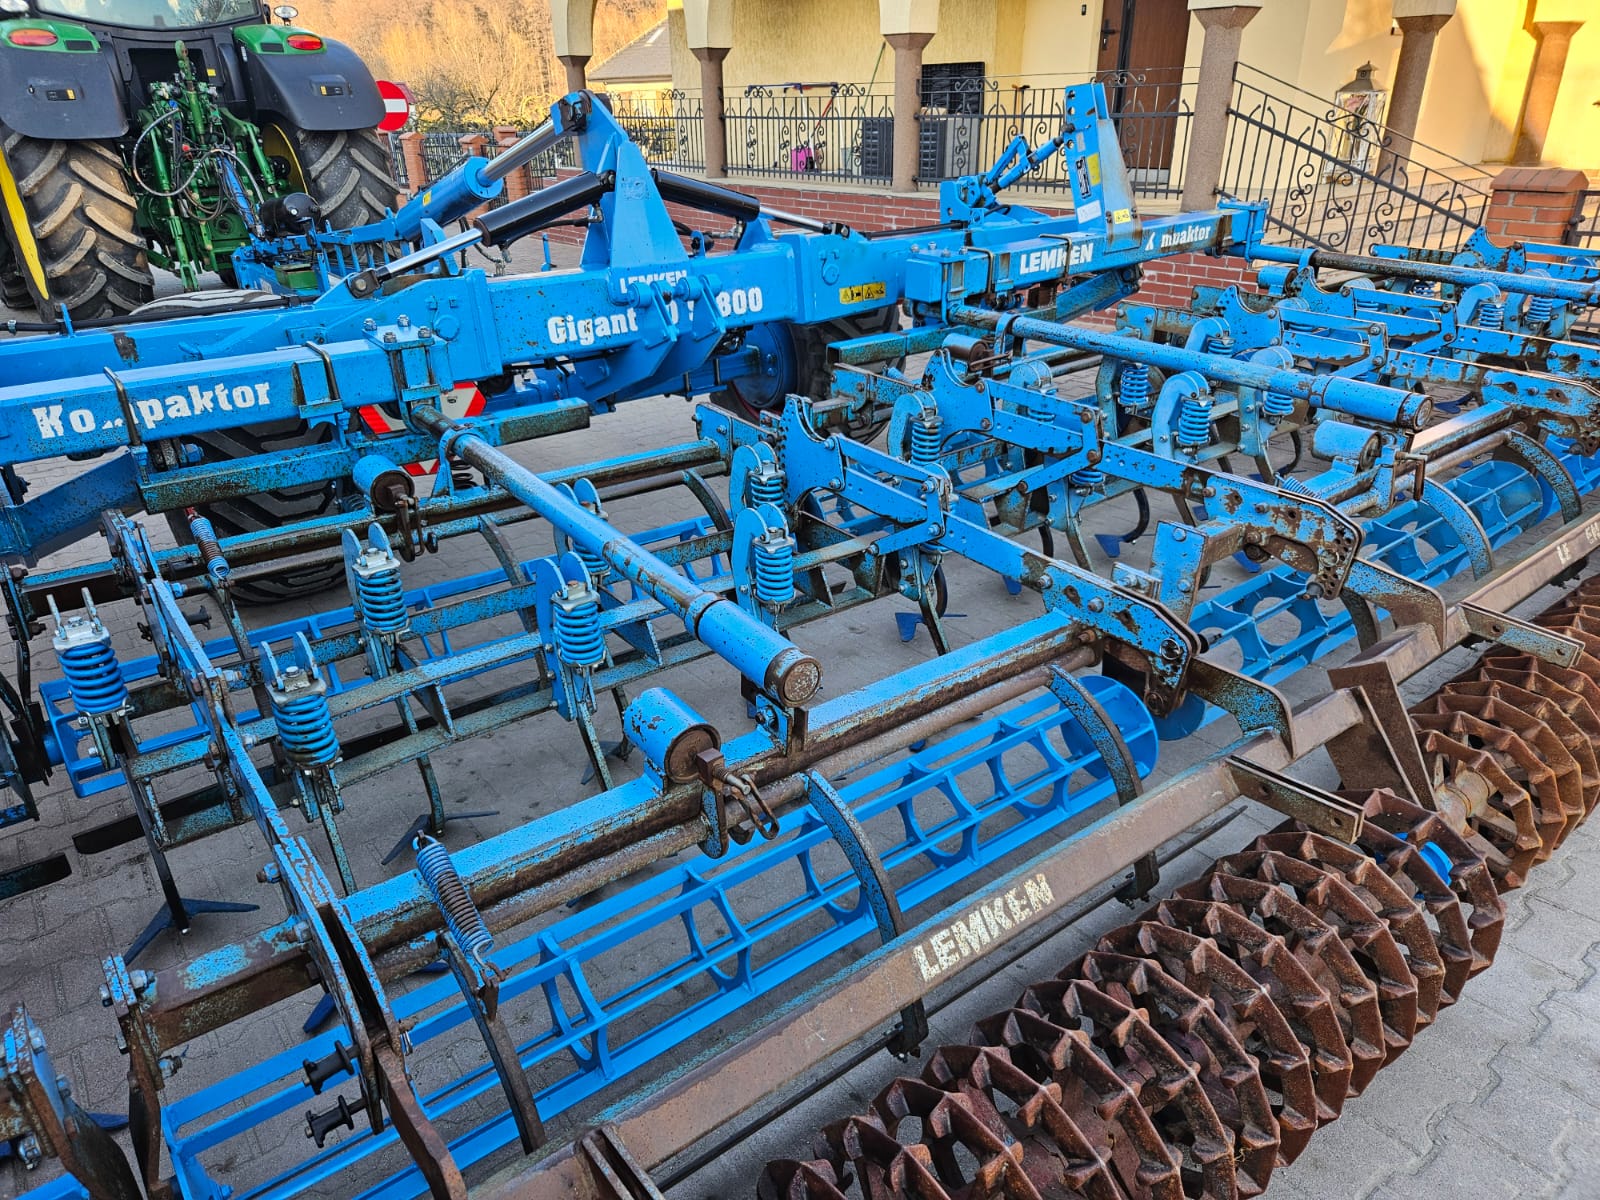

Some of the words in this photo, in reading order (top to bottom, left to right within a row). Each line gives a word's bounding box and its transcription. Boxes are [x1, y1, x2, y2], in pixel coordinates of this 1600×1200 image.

[1020, 243, 1094, 275] LEMKEN
[547, 307, 639, 346] Gigant
[32, 382, 271, 439] Kopaktor
[912, 873, 1056, 983] LEMKEN
